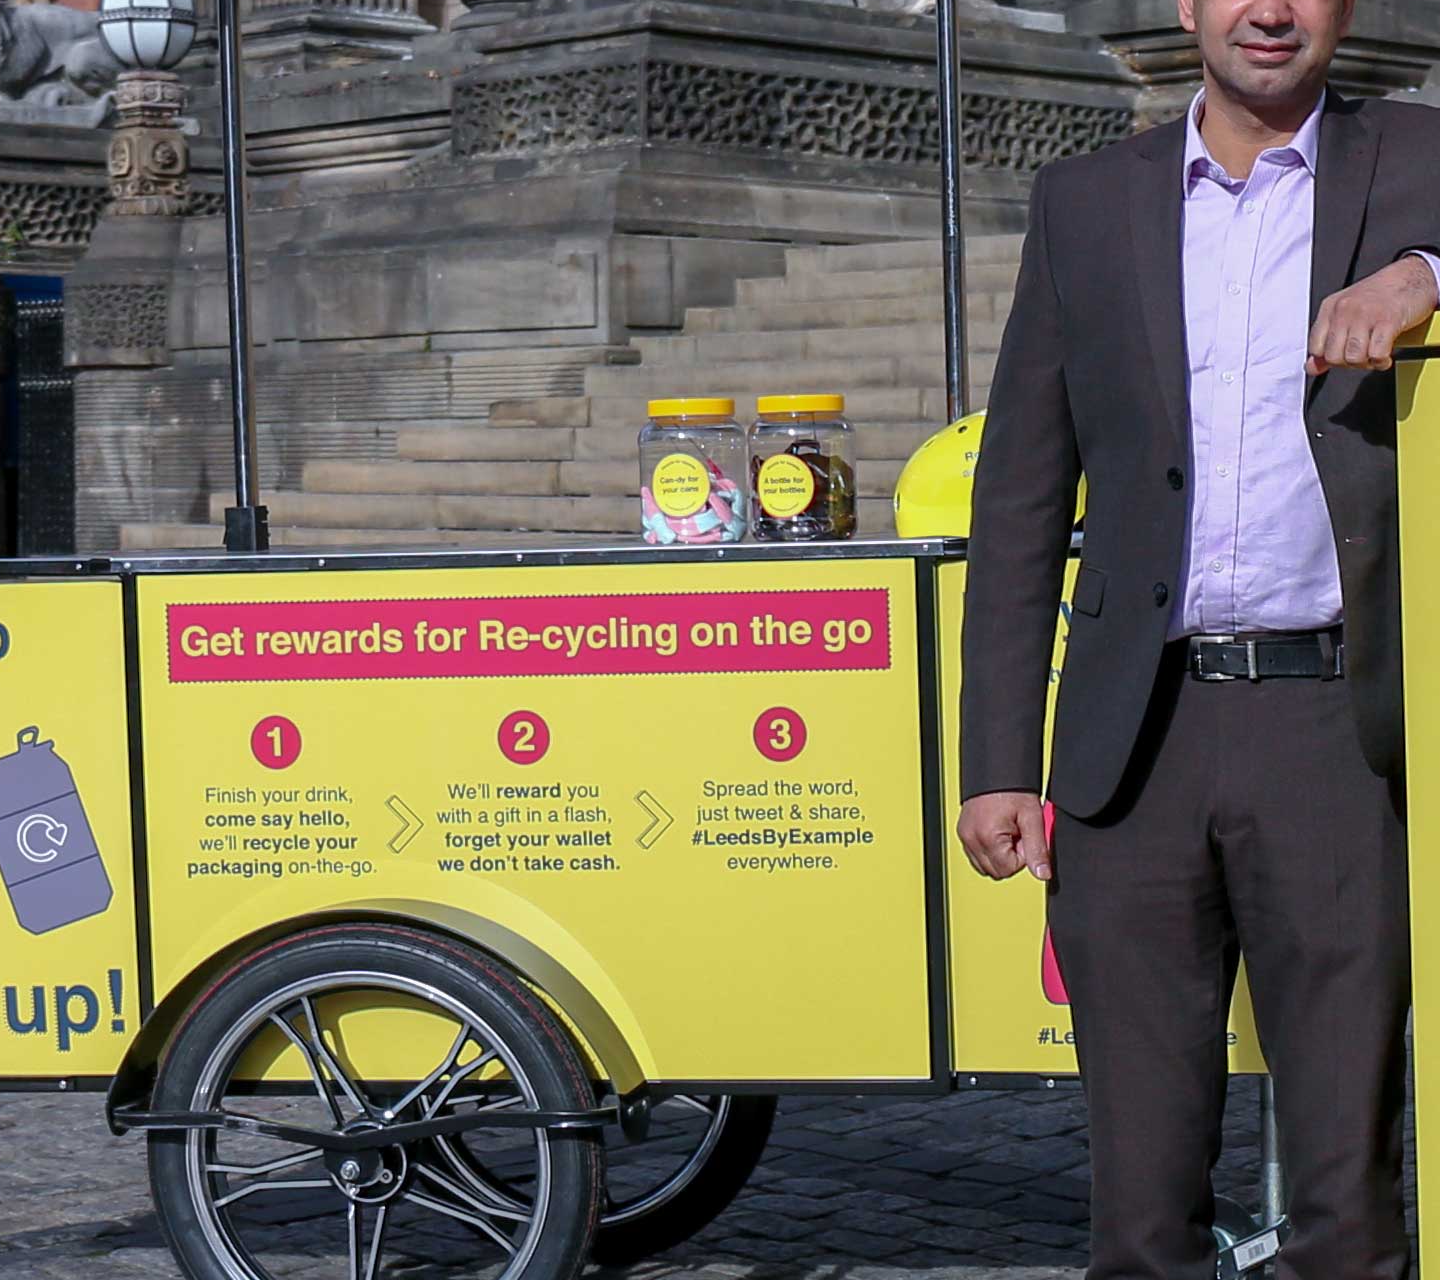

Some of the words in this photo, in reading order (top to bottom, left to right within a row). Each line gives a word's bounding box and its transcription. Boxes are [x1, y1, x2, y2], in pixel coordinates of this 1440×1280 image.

[180, 625, 245, 657] Get
[255, 622, 403, 656] rewards
[414, 620, 467, 653] for
[479, 617, 678, 658] Re-cycling
[690, 621, 739, 649] on
[749, 614, 813, 647] the
[823, 619, 872, 653] go
[266, 727, 284, 756] 1
[512, 722, 536, 752] 2
[769, 719, 791, 749] 3
[206, 787, 256, 803] Finish
[261, 790, 300, 807] your
[305, 786, 353, 804] drink,
[447, 783, 490, 799] We'll
[497, 782, 561, 799] reward
[567, 786, 599, 802] you
[703, 780, 768, 800] Spread
[774, 780, 802, 796] the
[808, 779, 858, 797] word,
[205, 815, 256, 827] come
[261, 814, 293, 830] say
[299, 810, 349, 829] hello,
[436, 808, 472, 824] with
[478, 811, 489, 823] a
[494, 807, 521, 827] gift
[526, 807, 542, 822] in
[548, 810, 559, 822] a
[564, 806, 612, 824] flash,
[696, 805, 729, 826] just
[734, 805, 784, 821] tweet
[790, 804, 803, 820] &
[809, 803, 865, 822] share,
[199, 835, 237, 851] we'll
[243, 834, 310, 854] recycle
[315, 837, 358, 854] your
[445, 832, 501, 851] forget
[506, 834, 550, 851] your
[555, 830, 612, 846] wallet
[691, 827, 873, 848] #LeedsByExample
[188, 858, 282, 879] packaging
[288, 858, 377, 877] on-the-go.
[437, 859, 464, 871] we
[470, 855, 519, 871] don't
[524, 855, 564, 871] take
[570, 854, 620, 870] cash.
[727, 853, 838, 873] everywhere.
[4, 968, 126, 1051] up!
